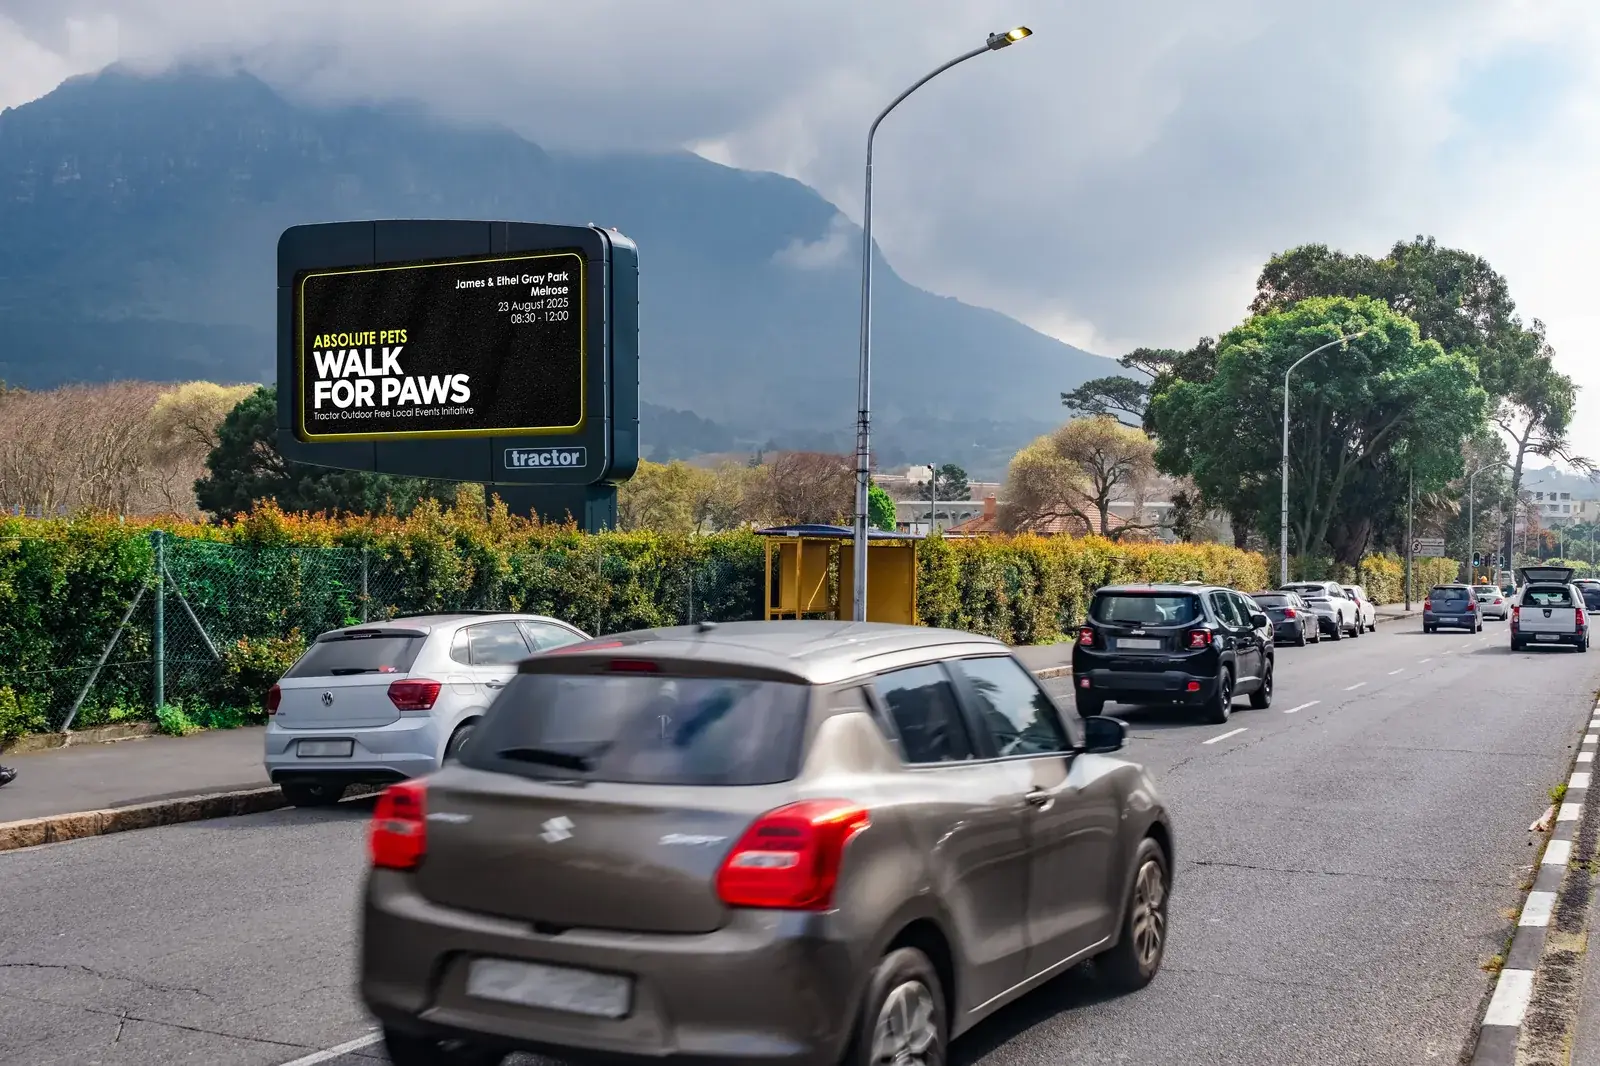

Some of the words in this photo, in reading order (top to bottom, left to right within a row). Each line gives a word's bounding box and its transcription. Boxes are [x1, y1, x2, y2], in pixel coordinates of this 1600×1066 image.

[455, 279, 485, 289] James
[487, 277, 494, 287] &
[496, 275, 519, 286] Ethel
[521, 274, 545, 285] Gray
[547, 271, 569, 282] Park
[530, 285, 569, 296] Melrose
[498, 301, 509, 312] 23
[511, 299, 544, 312] August
[546, 297, 569, 309] 2025
[510, 312, 536, 324] 08:30
[544, 310, 569, 322] 12:00
[313, 331, 376, 348] ABSOLUTE
[380, 329, 408, 344] PETS
[313, 346, 404, 379] WALK
[314, 378, 376, 409] FOR
[381, 373, 471, 406] PAWS
[314, 411, 340, 420] Tractor
[341, 409, 373, 419] Outdoor
[374, 409, 391, 418] Free
[392, 408, 414, 417] Local
[415, 407, 440, 417] Events
[441, 406, 474, 416] Initiative
[511, 449, 580, 466] tractor
